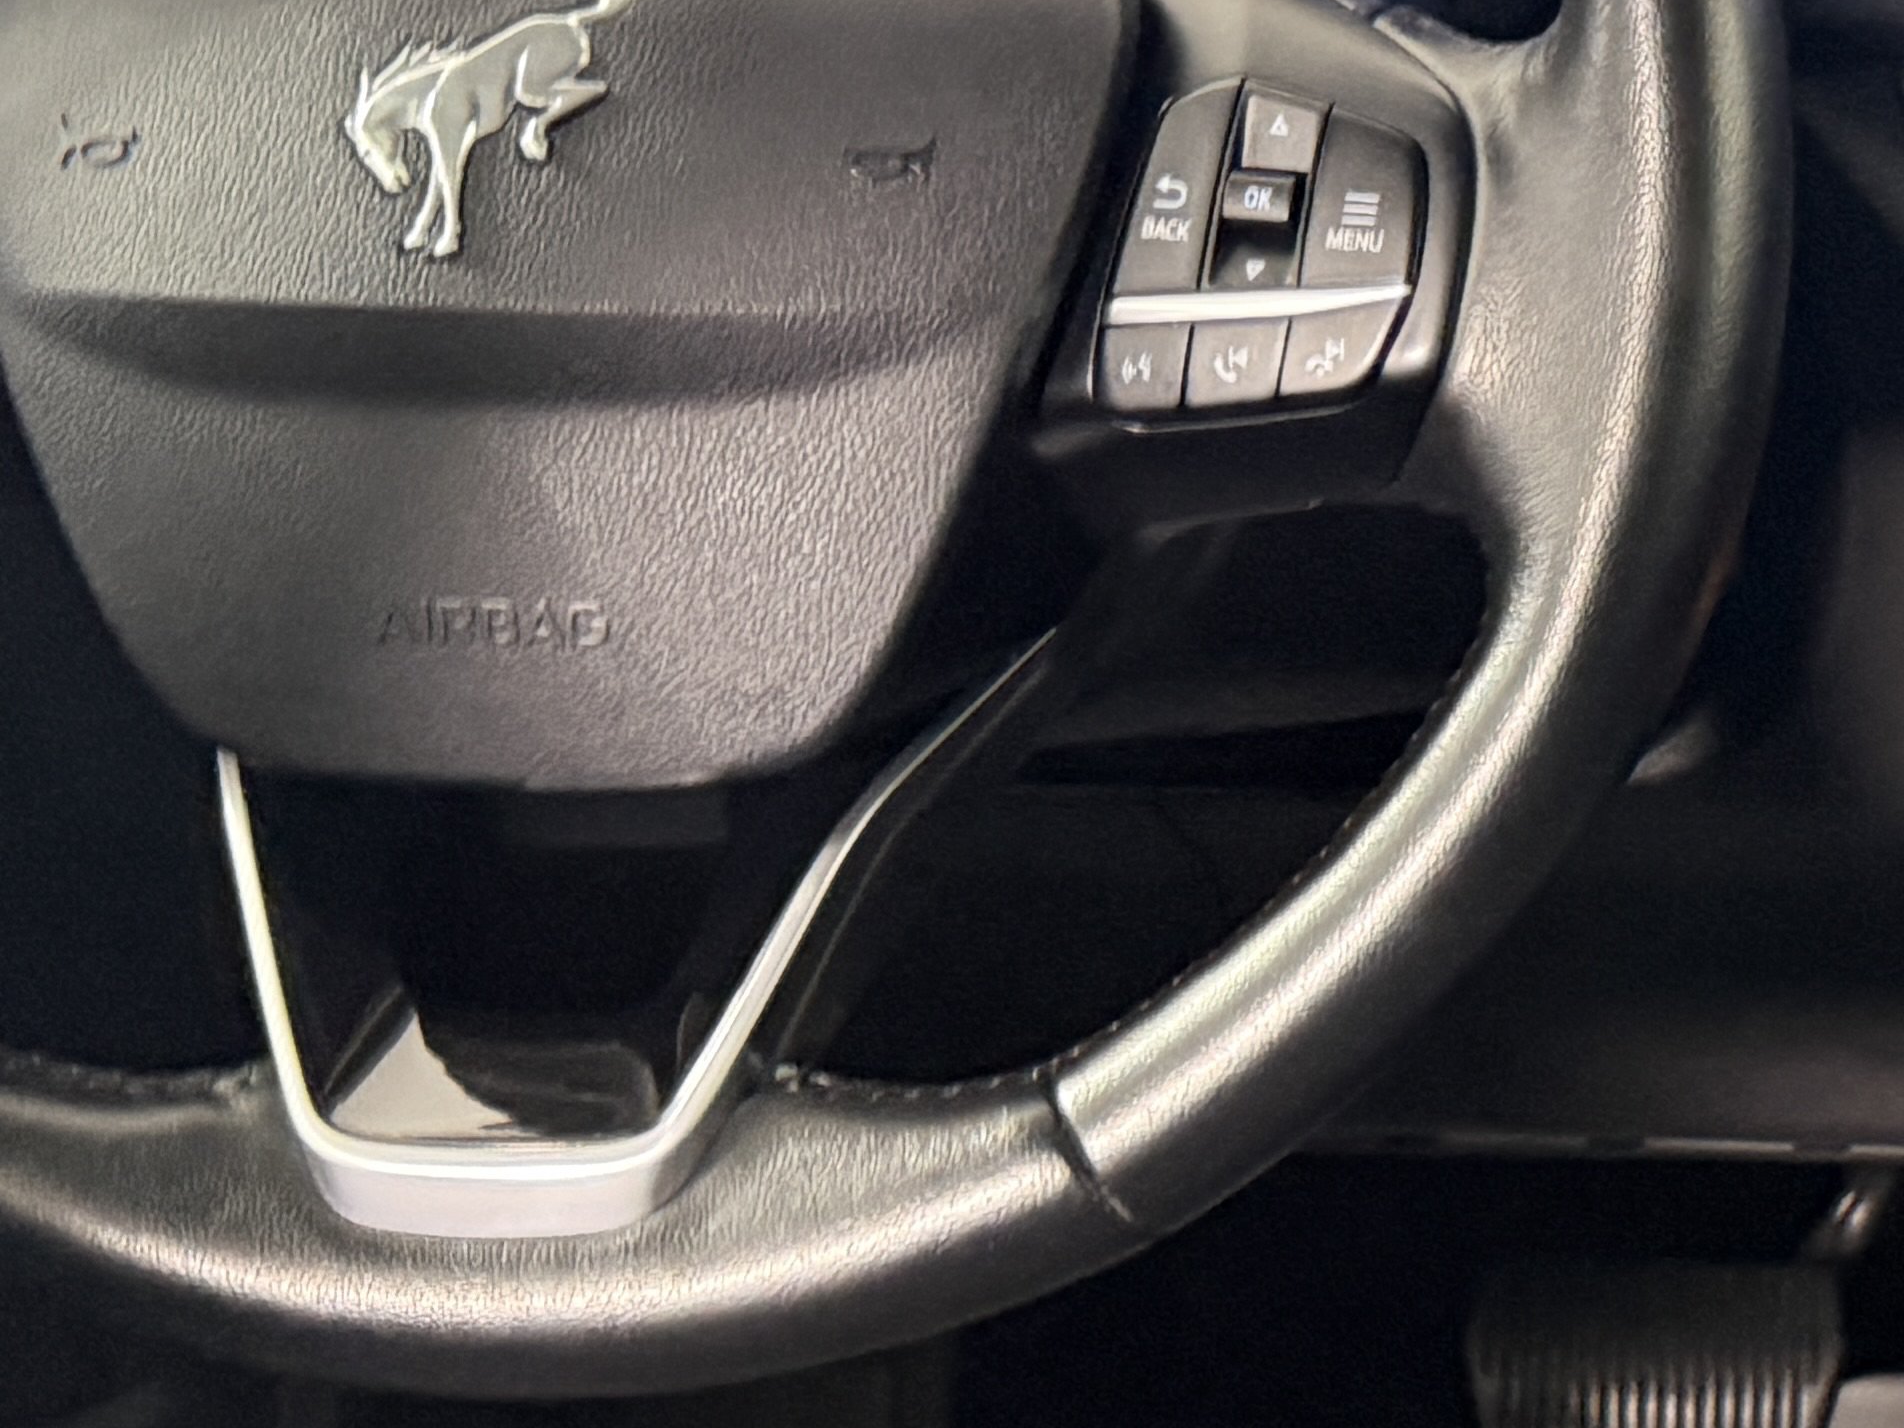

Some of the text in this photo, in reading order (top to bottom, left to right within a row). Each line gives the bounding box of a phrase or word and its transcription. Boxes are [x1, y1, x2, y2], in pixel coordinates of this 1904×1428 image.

[1244, 186, 1272, 210] OK
[1141, 217, 1192, 242] BACK
[1325, 228, 1384, 254] MENU
[378, 596, 611, 649] AIRBAG
